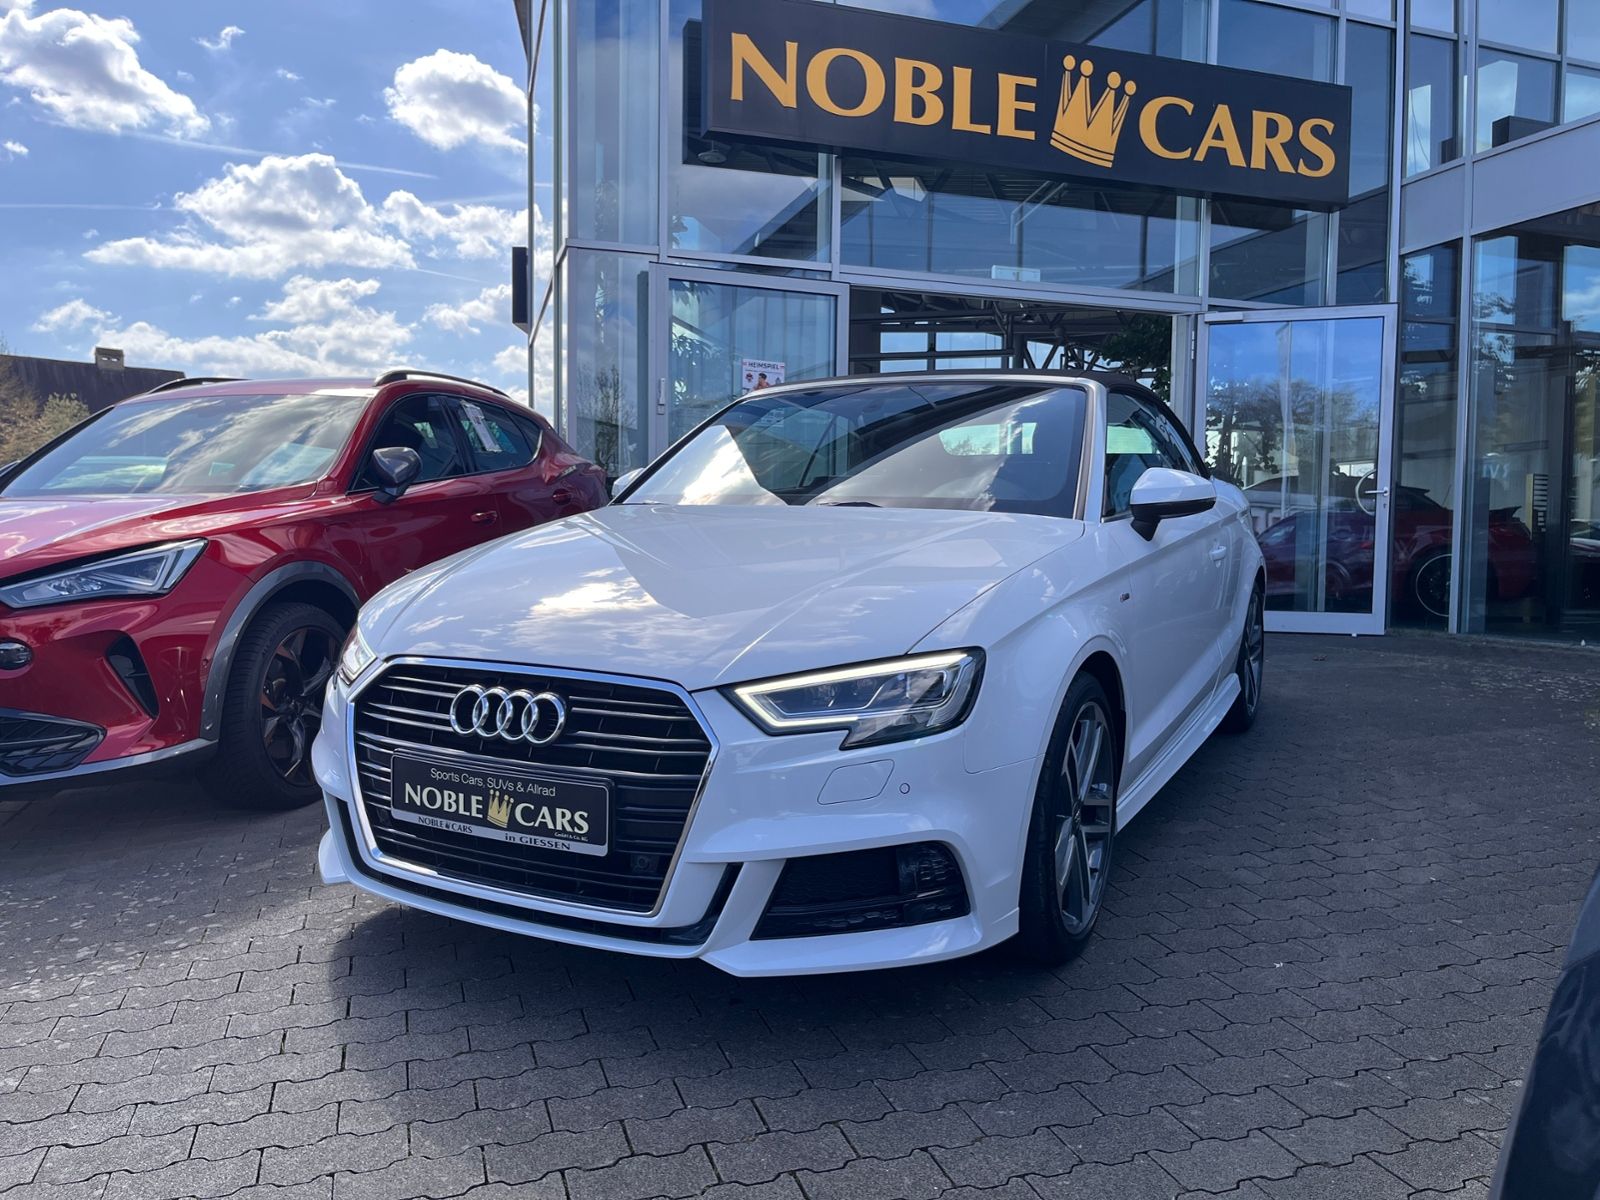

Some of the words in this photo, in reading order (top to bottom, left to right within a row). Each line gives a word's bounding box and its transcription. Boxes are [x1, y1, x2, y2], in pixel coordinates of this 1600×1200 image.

[731, 32, 1037, 140] NOBLE
[1138, 96, 1336, 178] CARS
[748, 361, 780, 370] HEIMSPIEL
[430, 768, 460, 782] Sports
[461, 773, 485, 787] Cars,
[487, 777, 514, 792] SUVs
[516, 782, 525, 793] &
[526, 783, 556, 797] Allrad
[404, 782, 484, 818] NOBLE
[514, 802, 590, 834] CARS
[417, 816, 444, 828] NOBLE
[451, 822, 473, 834] CARS
[504, 832, 516, 842] in
[519, 835, 571, 850] GIESSEN
